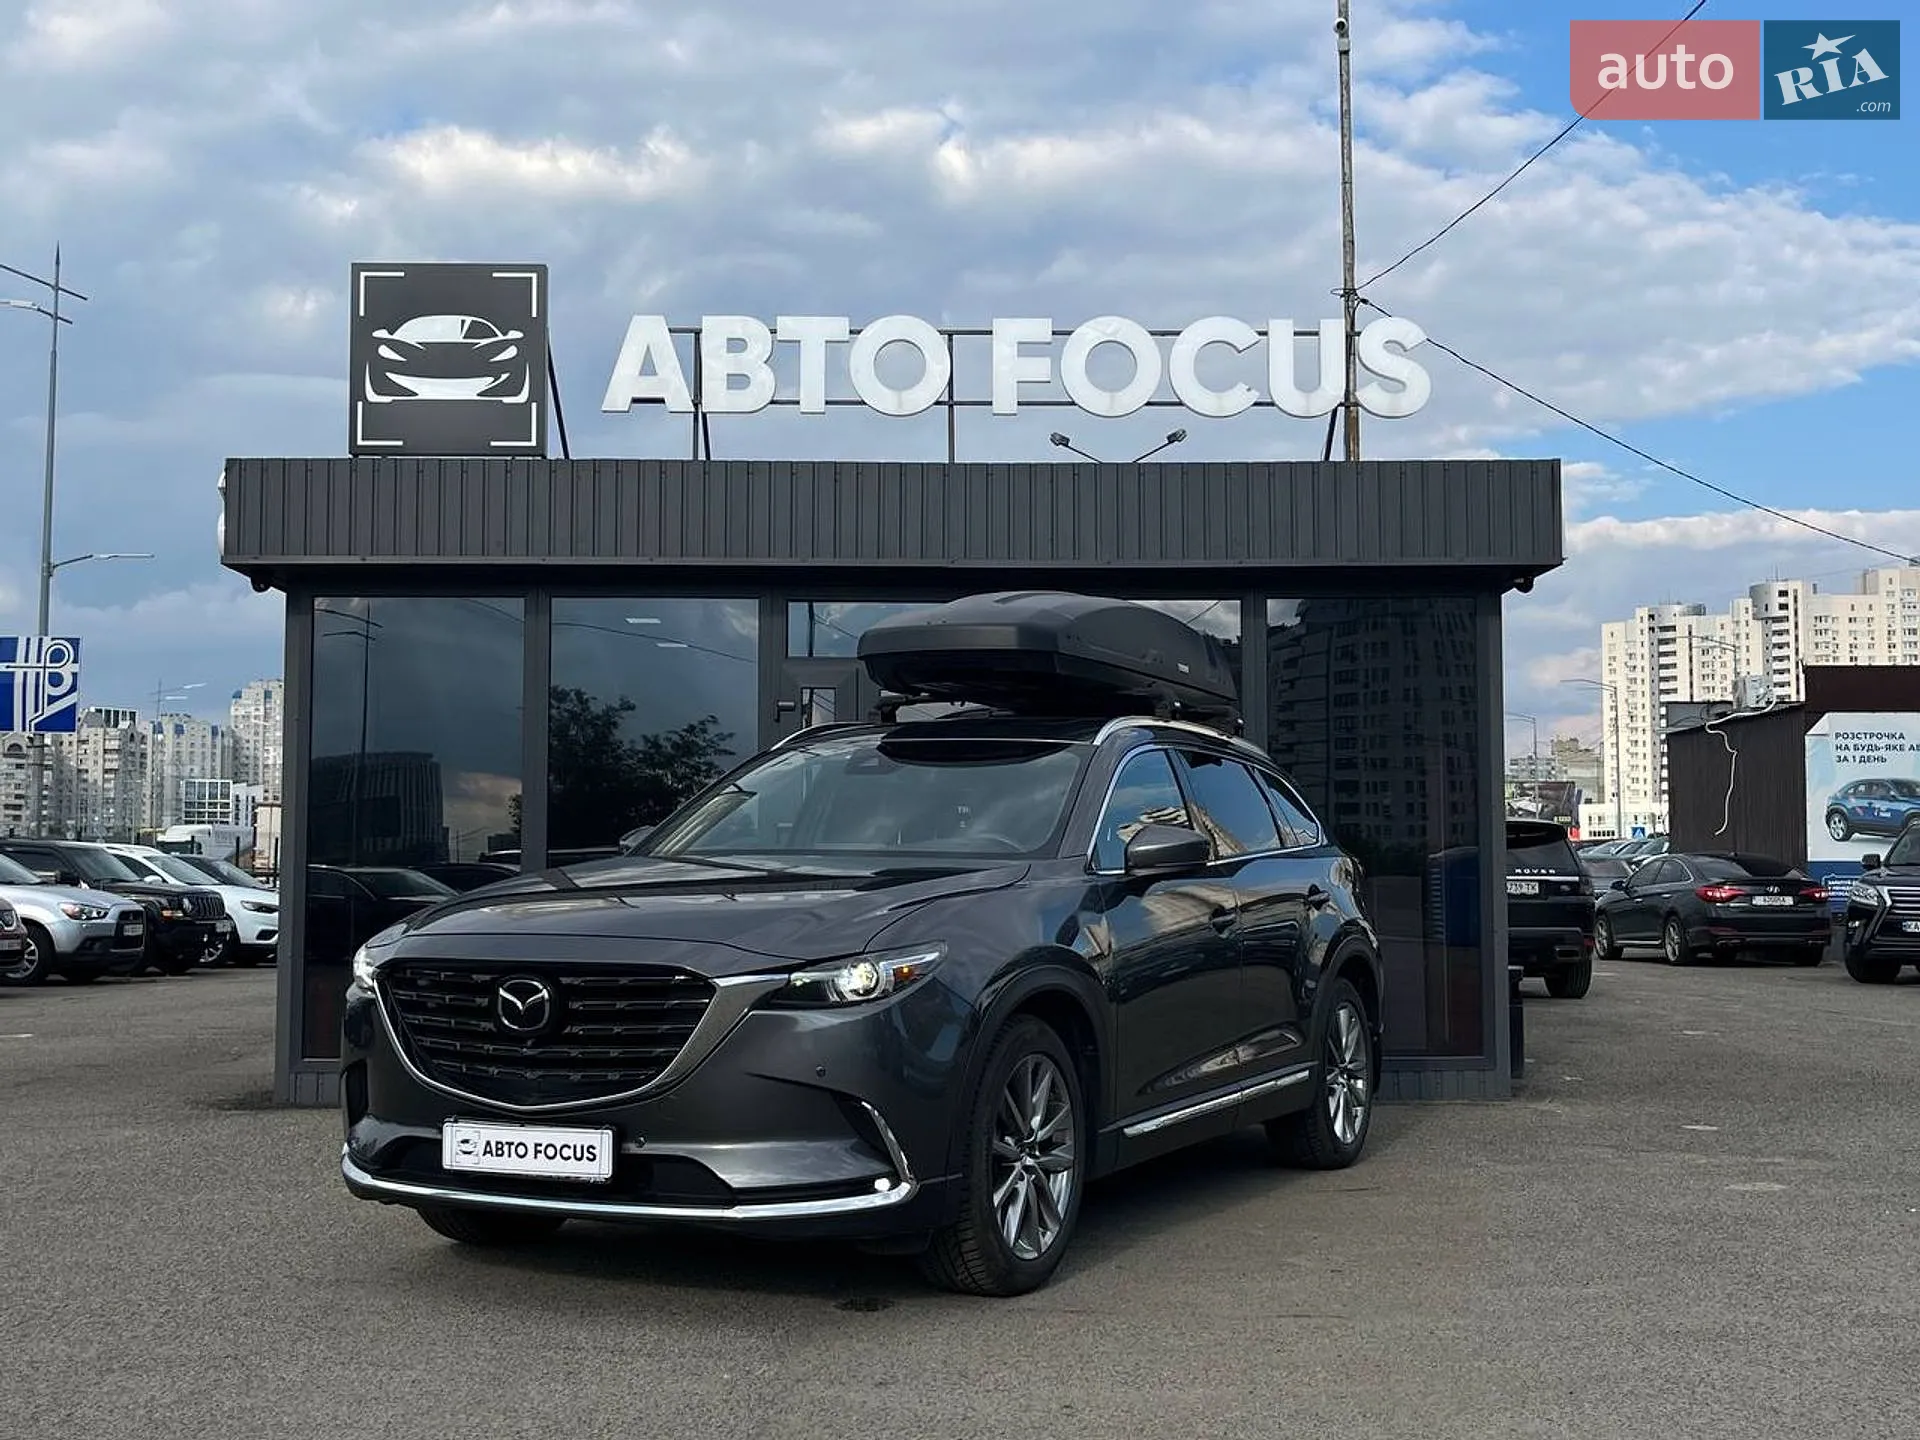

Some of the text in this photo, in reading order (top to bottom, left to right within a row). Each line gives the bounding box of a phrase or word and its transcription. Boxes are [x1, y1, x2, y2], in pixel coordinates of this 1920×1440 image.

[991, 315, 1432, 419] FOCUS
[1834, 732, 1906, 740] РОЗСТРОЧКА
[1835, 743, 1851, 752] НА
[1853, 743, 1906, 753] БУДЬ-ЯКЕ
[1836, 755, 1850, 763] ЗА
[1859, 755, 1887, 764] ДЕНЬ
[533, 1142, 598, 1163] FOCUS
